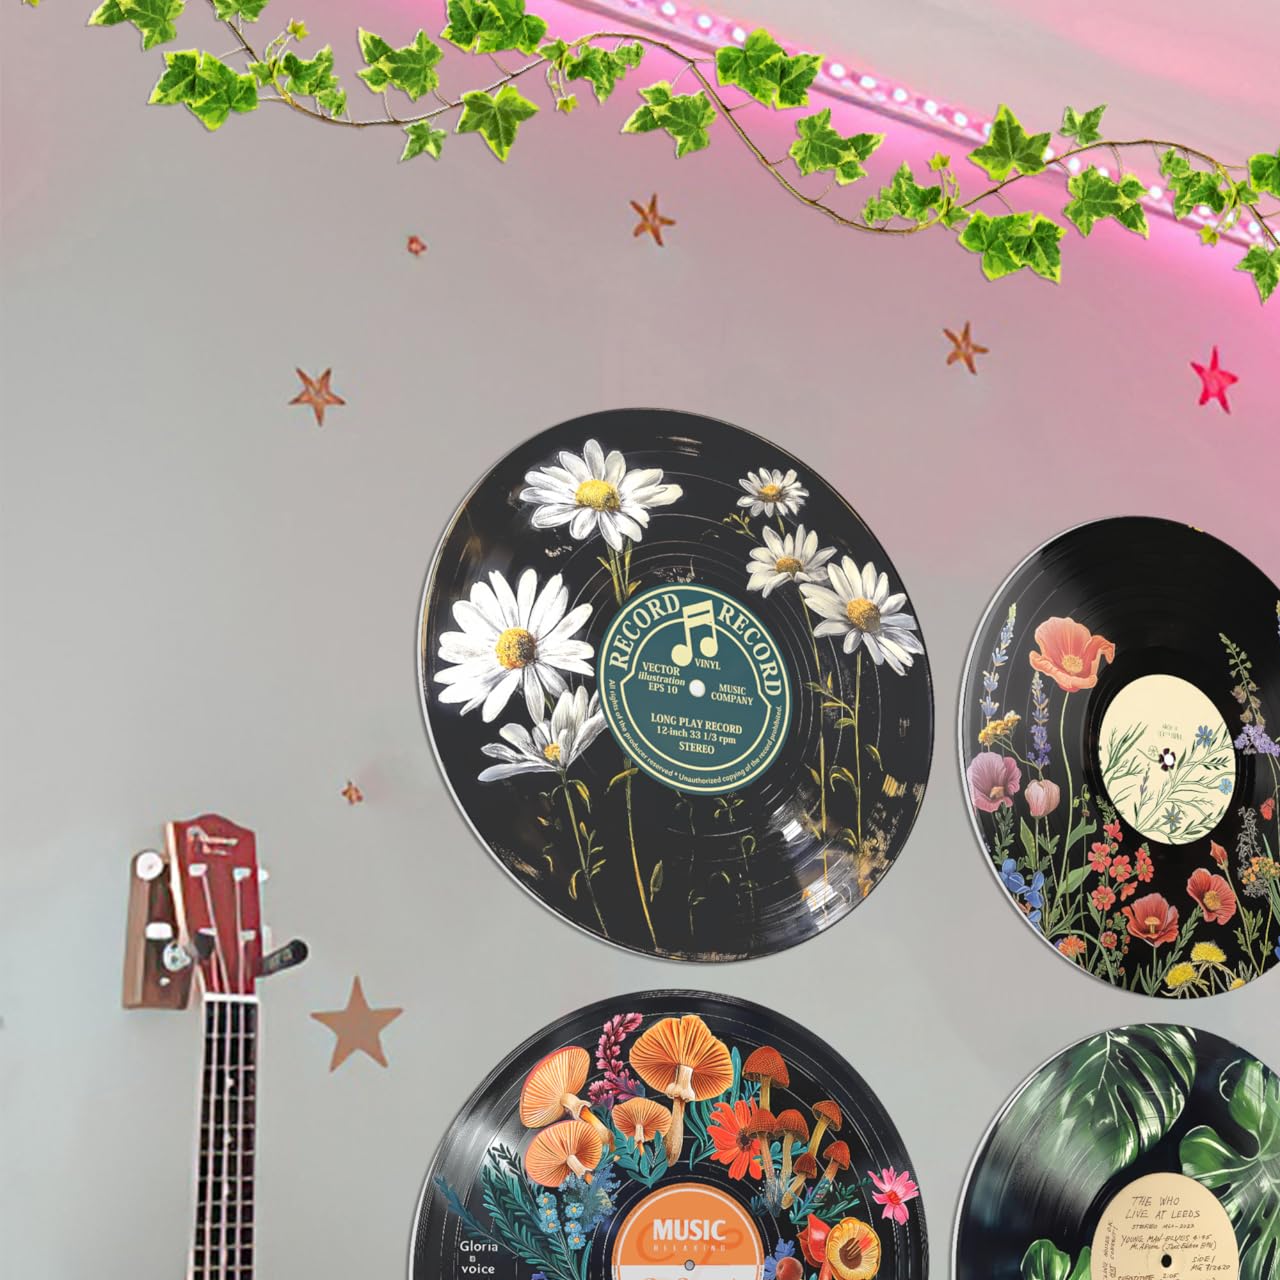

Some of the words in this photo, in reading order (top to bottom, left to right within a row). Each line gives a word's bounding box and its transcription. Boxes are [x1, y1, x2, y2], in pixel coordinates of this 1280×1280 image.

[609, 593, 680, 671] RECORD
[717, 602, 782, 696] RECORD
[642, 661, 680, 677] VECTOR
[695, 658, 721, 671] VINYL
[608, 679, 616, 690] All
[638, 671, 685, 687] illustration
[648, 682, 665, 693] EPS
[667, 685, 678, 695] 10
[719, 683, 746, 696] MUSIC
[608, 690, 620, 711] rights
[711, 692, 753, 706] COMPANY
[618, 719, 628, 732] the
[650, 712, 677, 726] LONG
[678, 716, 704, 729] PLAY
[705, 720, 743, 735] RECORD
[657, 725, 688, 738] 12-inch
[689, 729, 701, 740] 33
[703, 732, 718, 742] 1/3
[719, 735, 737, 746] rpm
[623, 731, 648, 760] producer
[679, 741, 716, 755] STEREO
[758, 739, 773, 759] record
[647, 758, 674, 777] reserved
[678, 773, 722, 785] Unauthorized
[722, 769, 746, 783] copying
[1131, 1196, 1152, 1207] THE
[1159, 1195, 1180, 1206] WHO
[1125, 1208, 1149, 1219] LIVE
[1155, 1209, 1167, 1220] AT
[1171, 1209, 1200, 1219] LEEDS
[653, 1218, 726, 1241] MUSIC
[459, 1239, 498, 1252] Gloria
[461, 1263, 496, 1274] voice
